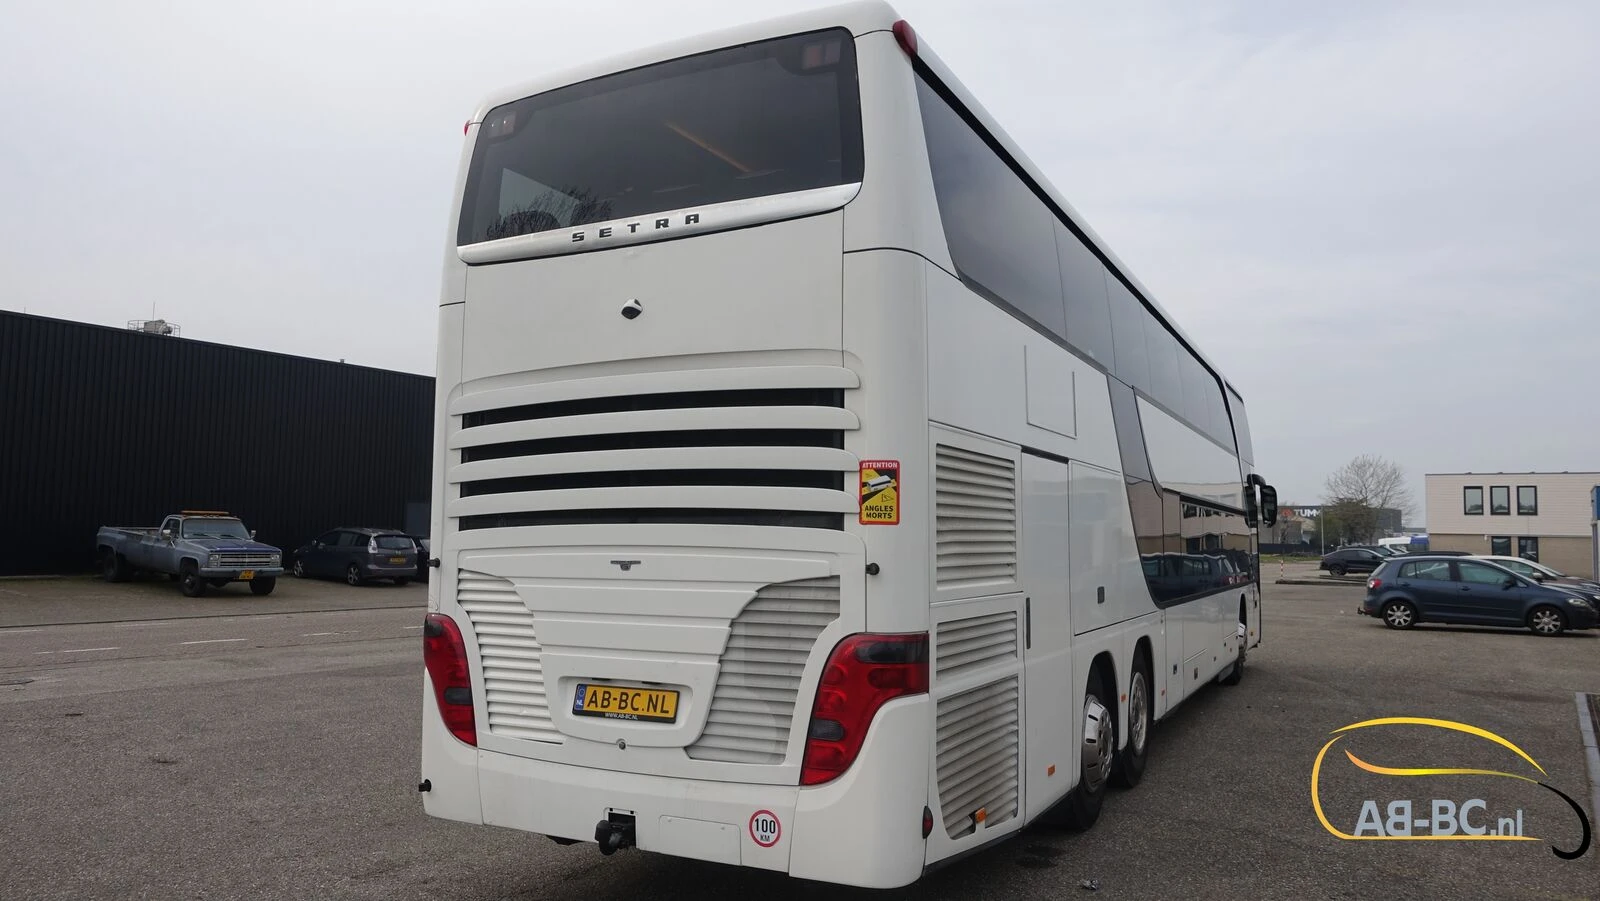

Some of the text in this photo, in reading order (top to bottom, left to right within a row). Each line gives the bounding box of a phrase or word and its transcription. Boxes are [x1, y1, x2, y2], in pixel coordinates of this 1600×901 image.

[572, 213, 700, 242] SETRA
[587, 690, 670, 714] AB-BC.NL
[755, 818, 776, 834] 100
